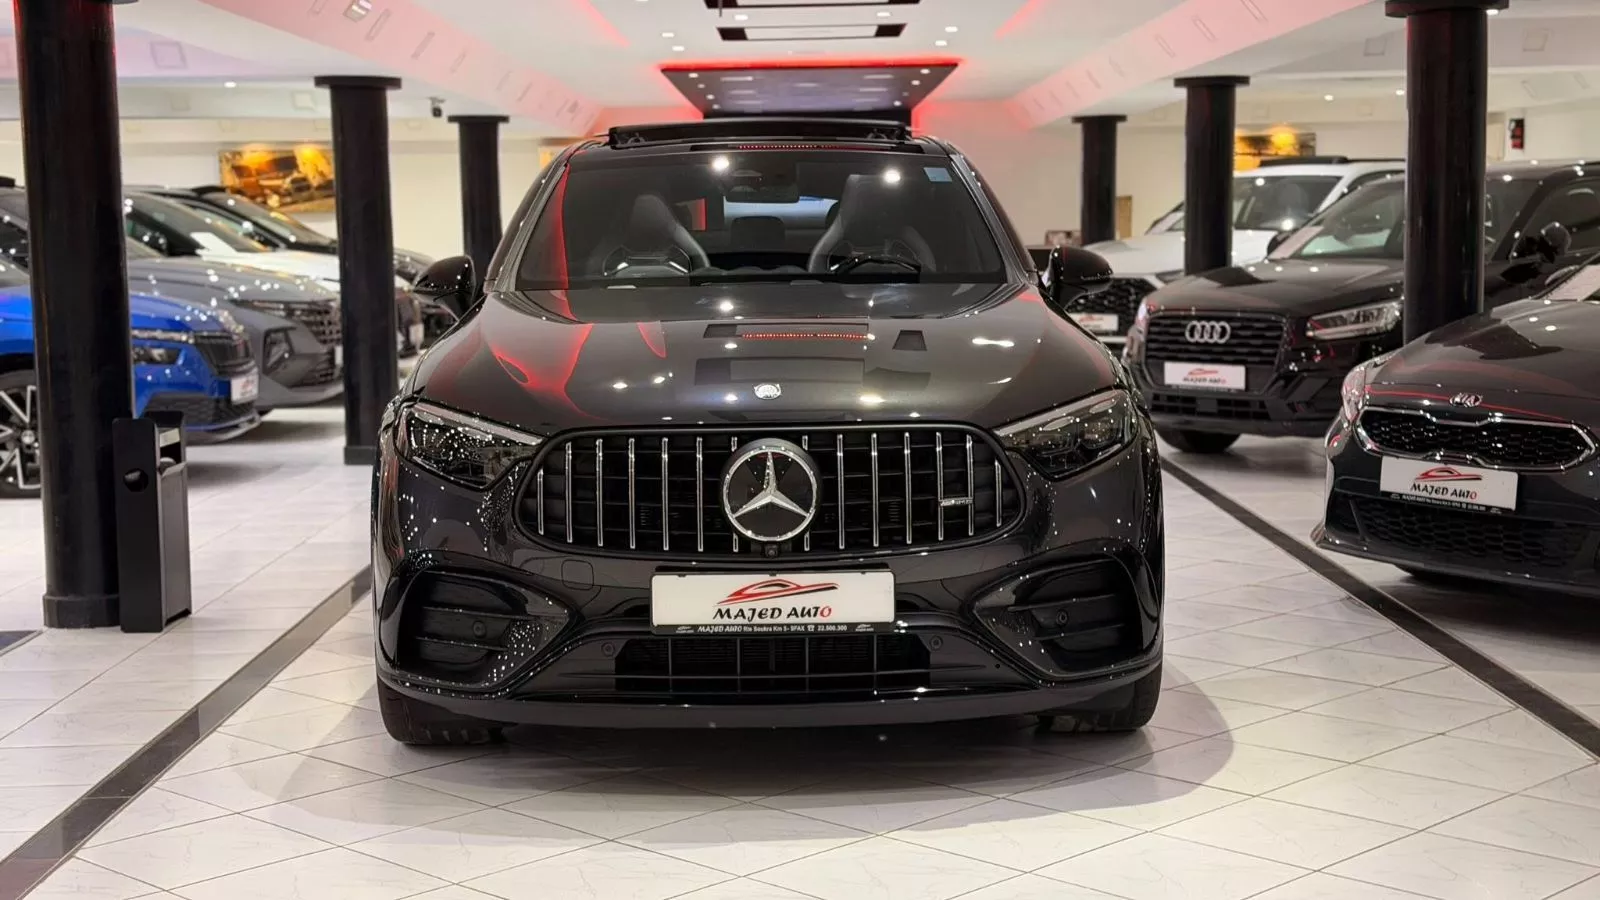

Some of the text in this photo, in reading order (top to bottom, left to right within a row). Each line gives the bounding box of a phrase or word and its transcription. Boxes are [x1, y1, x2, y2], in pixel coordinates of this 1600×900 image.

[1410, 482, 1478, 500] MAJED AUTO
[712, 605, 832, 622] MAJED AUTO
